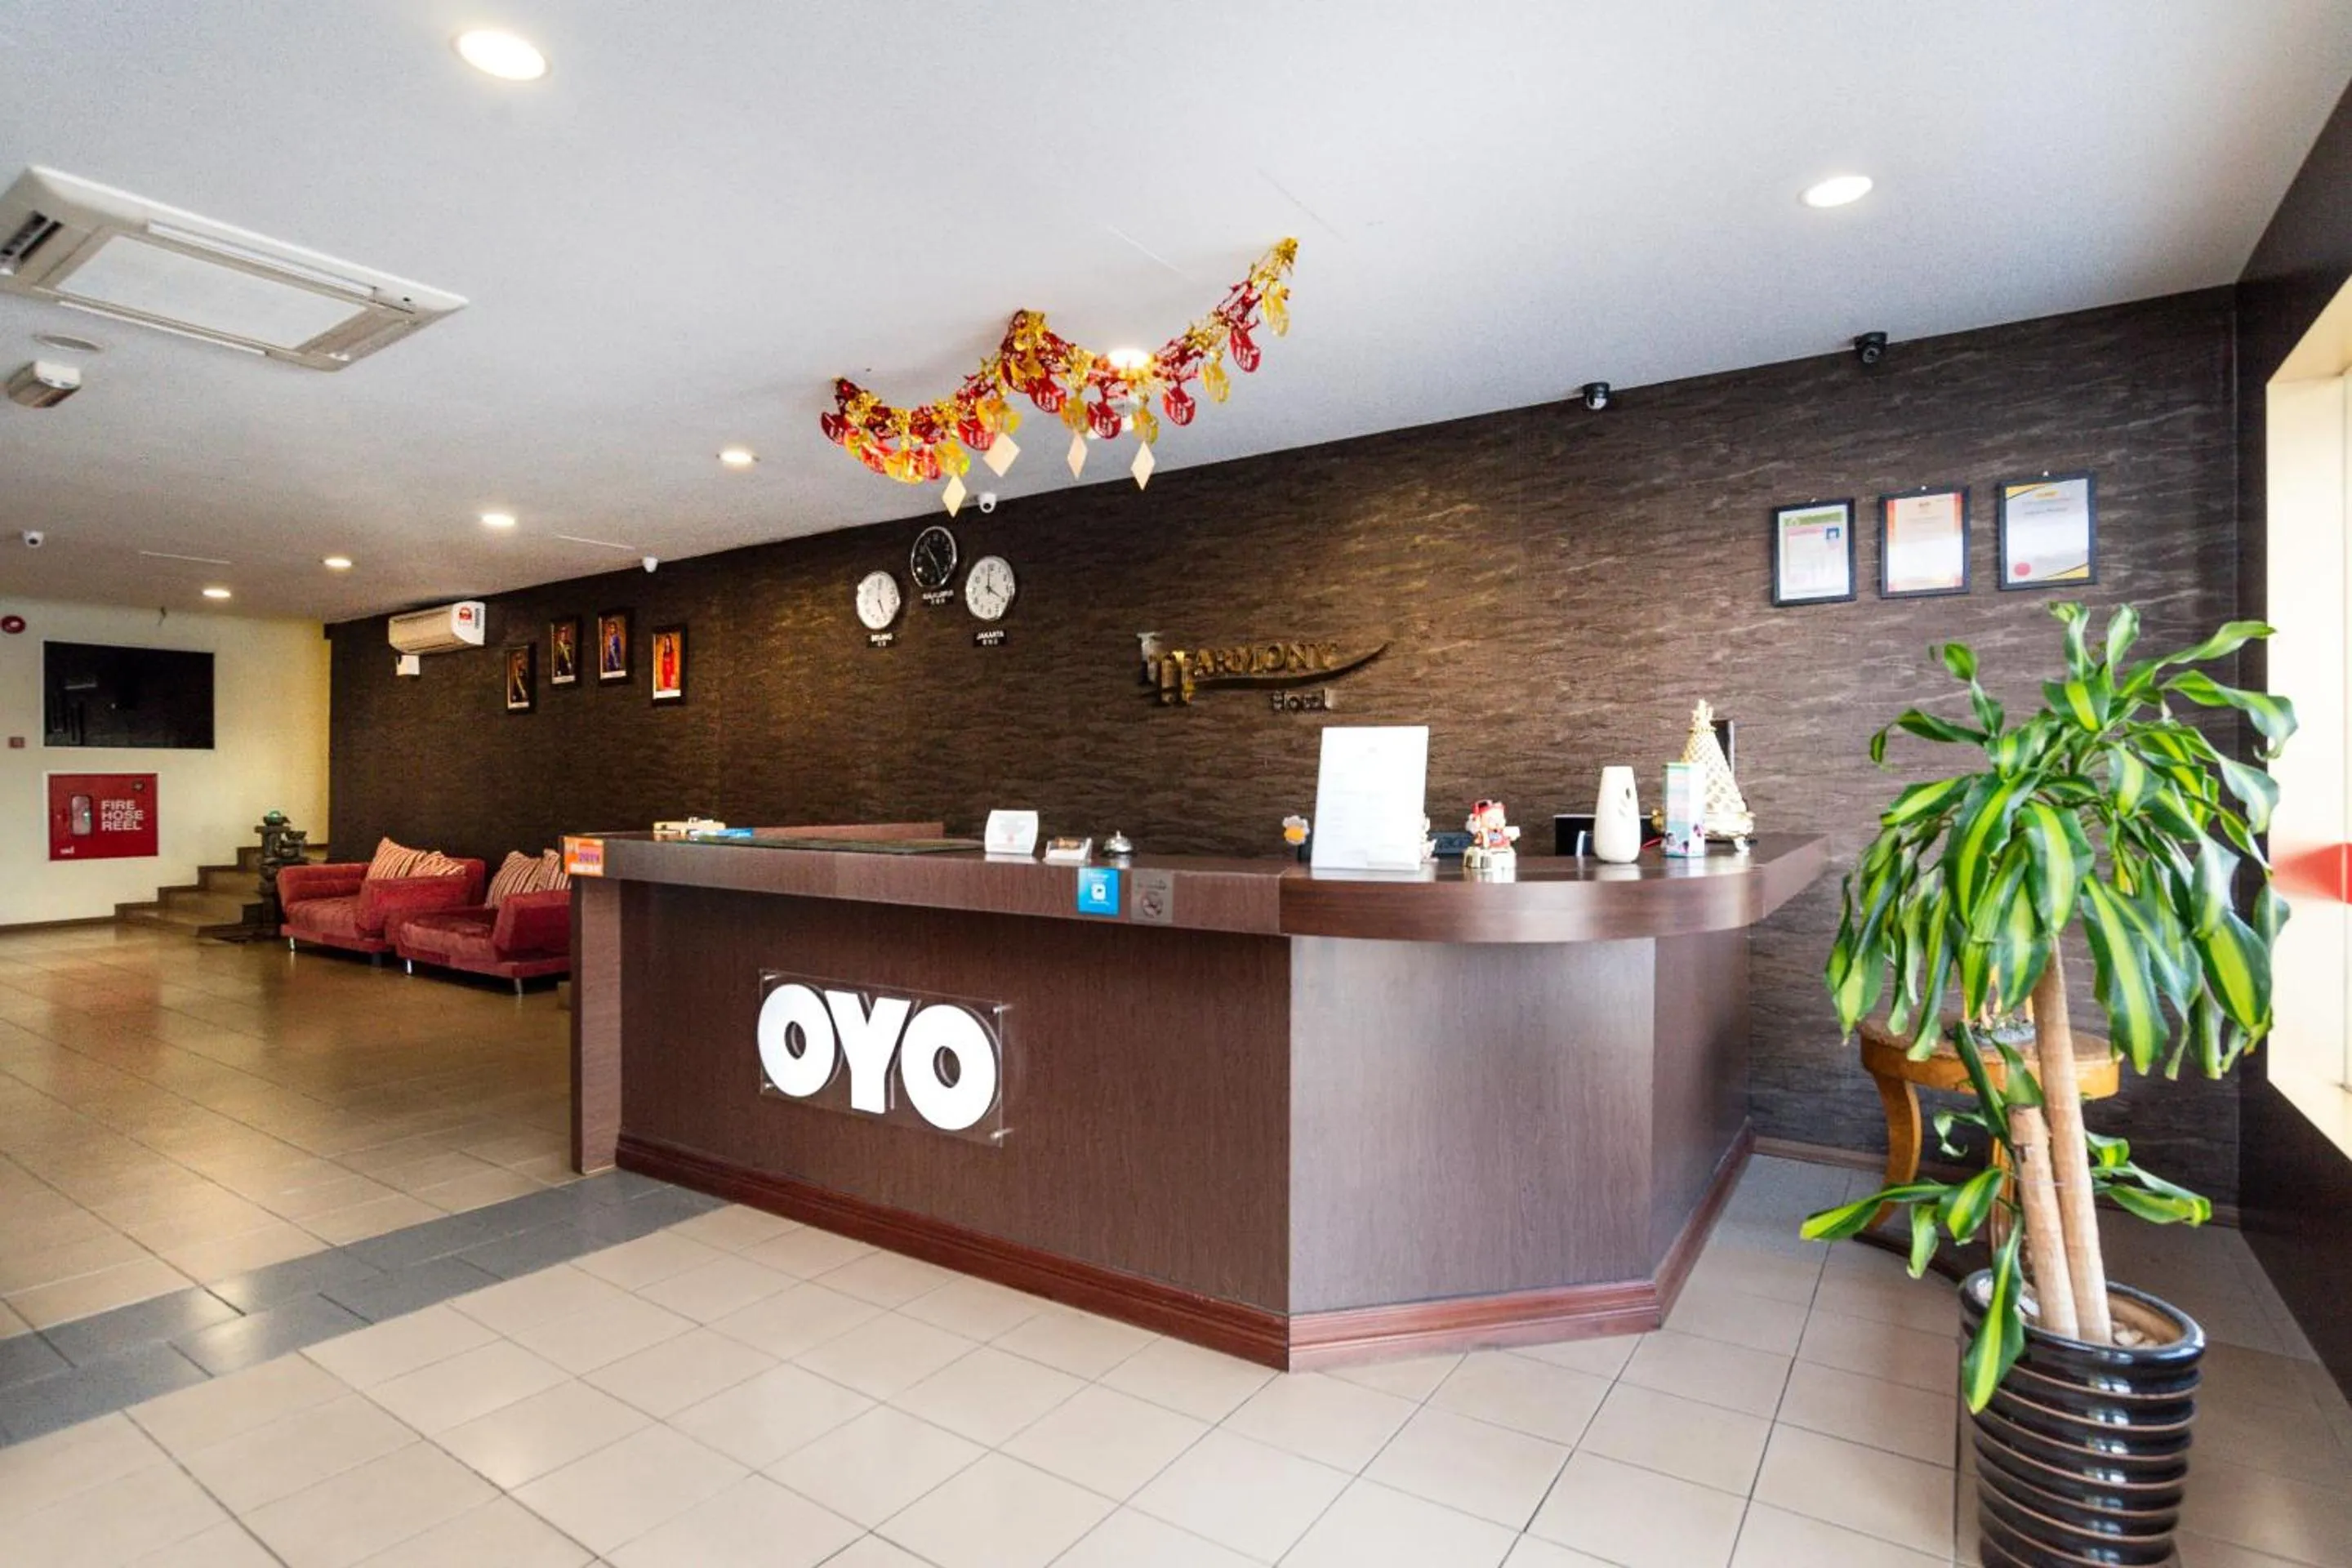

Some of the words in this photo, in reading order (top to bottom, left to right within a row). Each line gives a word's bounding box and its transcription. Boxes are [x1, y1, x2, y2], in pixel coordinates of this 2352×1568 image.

[100, 800, 136, 810] FIRE
[100, 809, 144, 821] HOSE
[100, 820, 143, 831] REEL
[757, 983, 997, 1131] OYO
